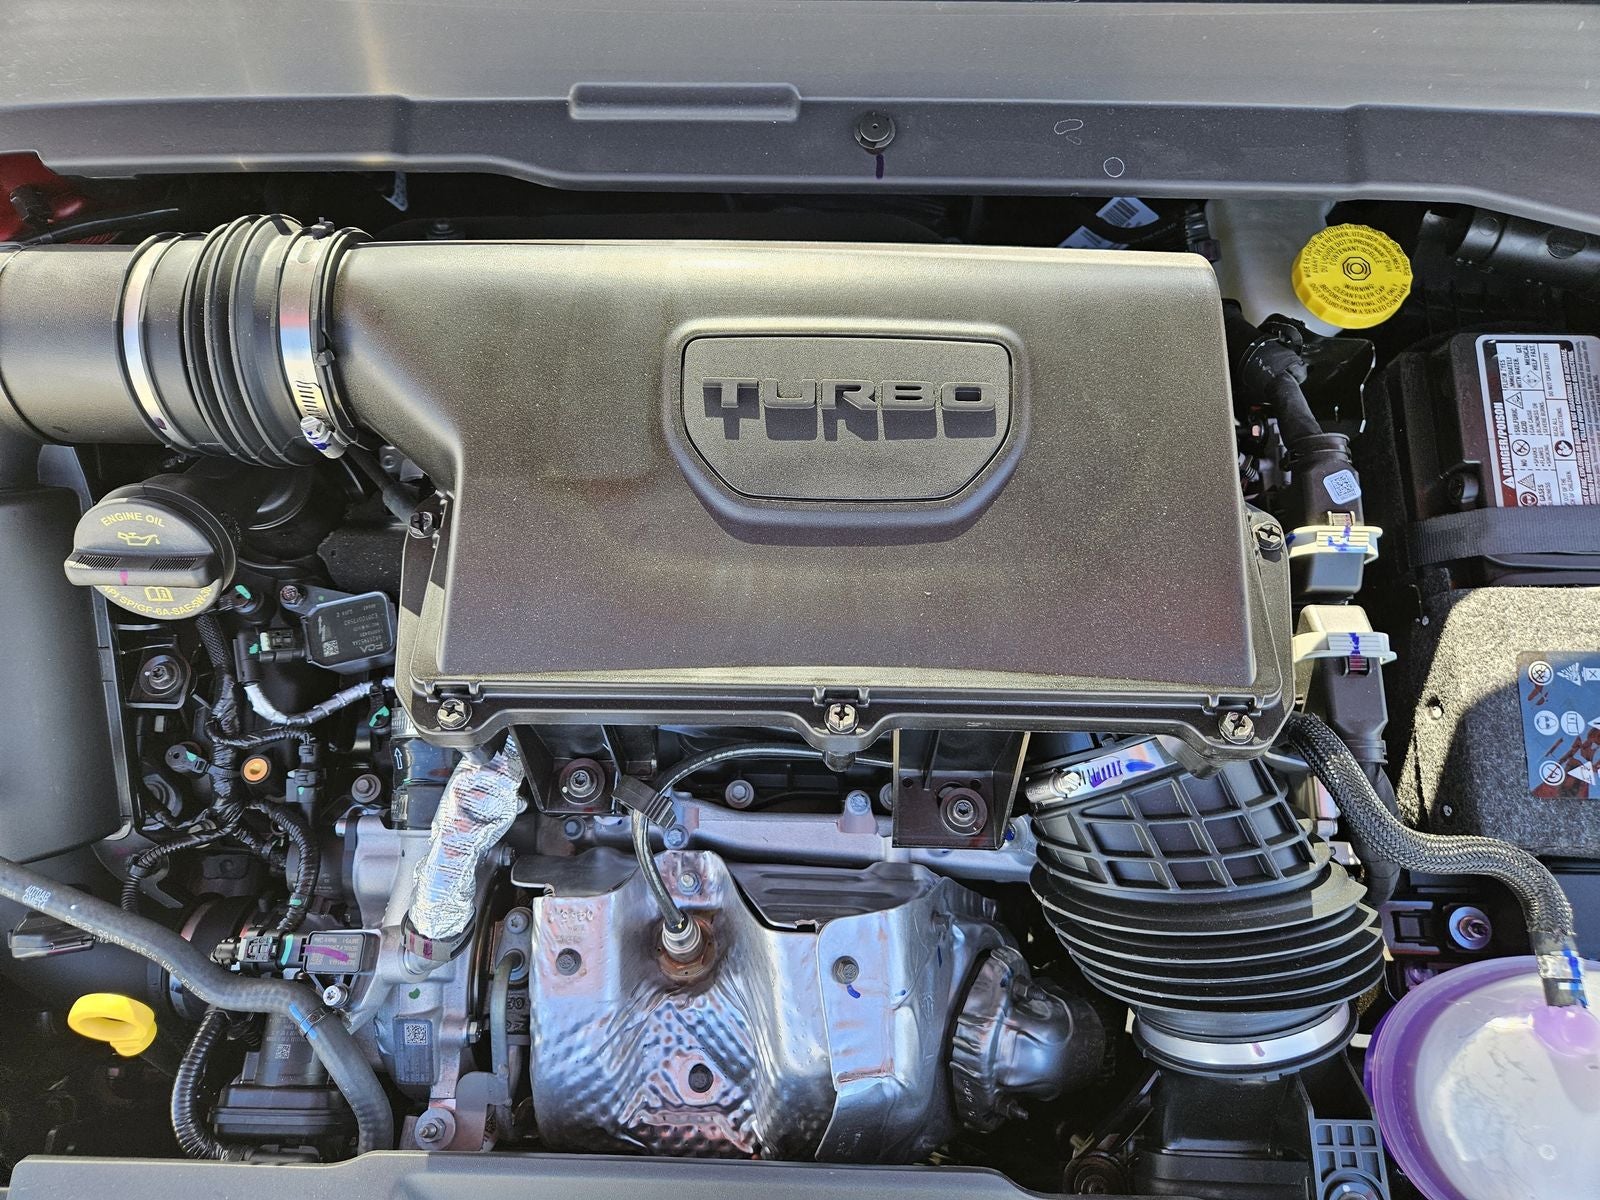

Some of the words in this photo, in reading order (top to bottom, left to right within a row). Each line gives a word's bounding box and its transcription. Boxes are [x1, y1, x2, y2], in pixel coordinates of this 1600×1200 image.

[1320, 284, 1341, 301] BEFORE
[1333, 286, 1354, 299] CLEAN
[702, 377, 997, 413] TURBO
[1511, 408, 1520, 432] SULFURIC
[1493, 402, 1512, 475] DANGER/POISON
[101, 512, 143, 527] ENGINE
[145, 514, 166, 528] OIL
[360, 642, 384, 653] FCA
